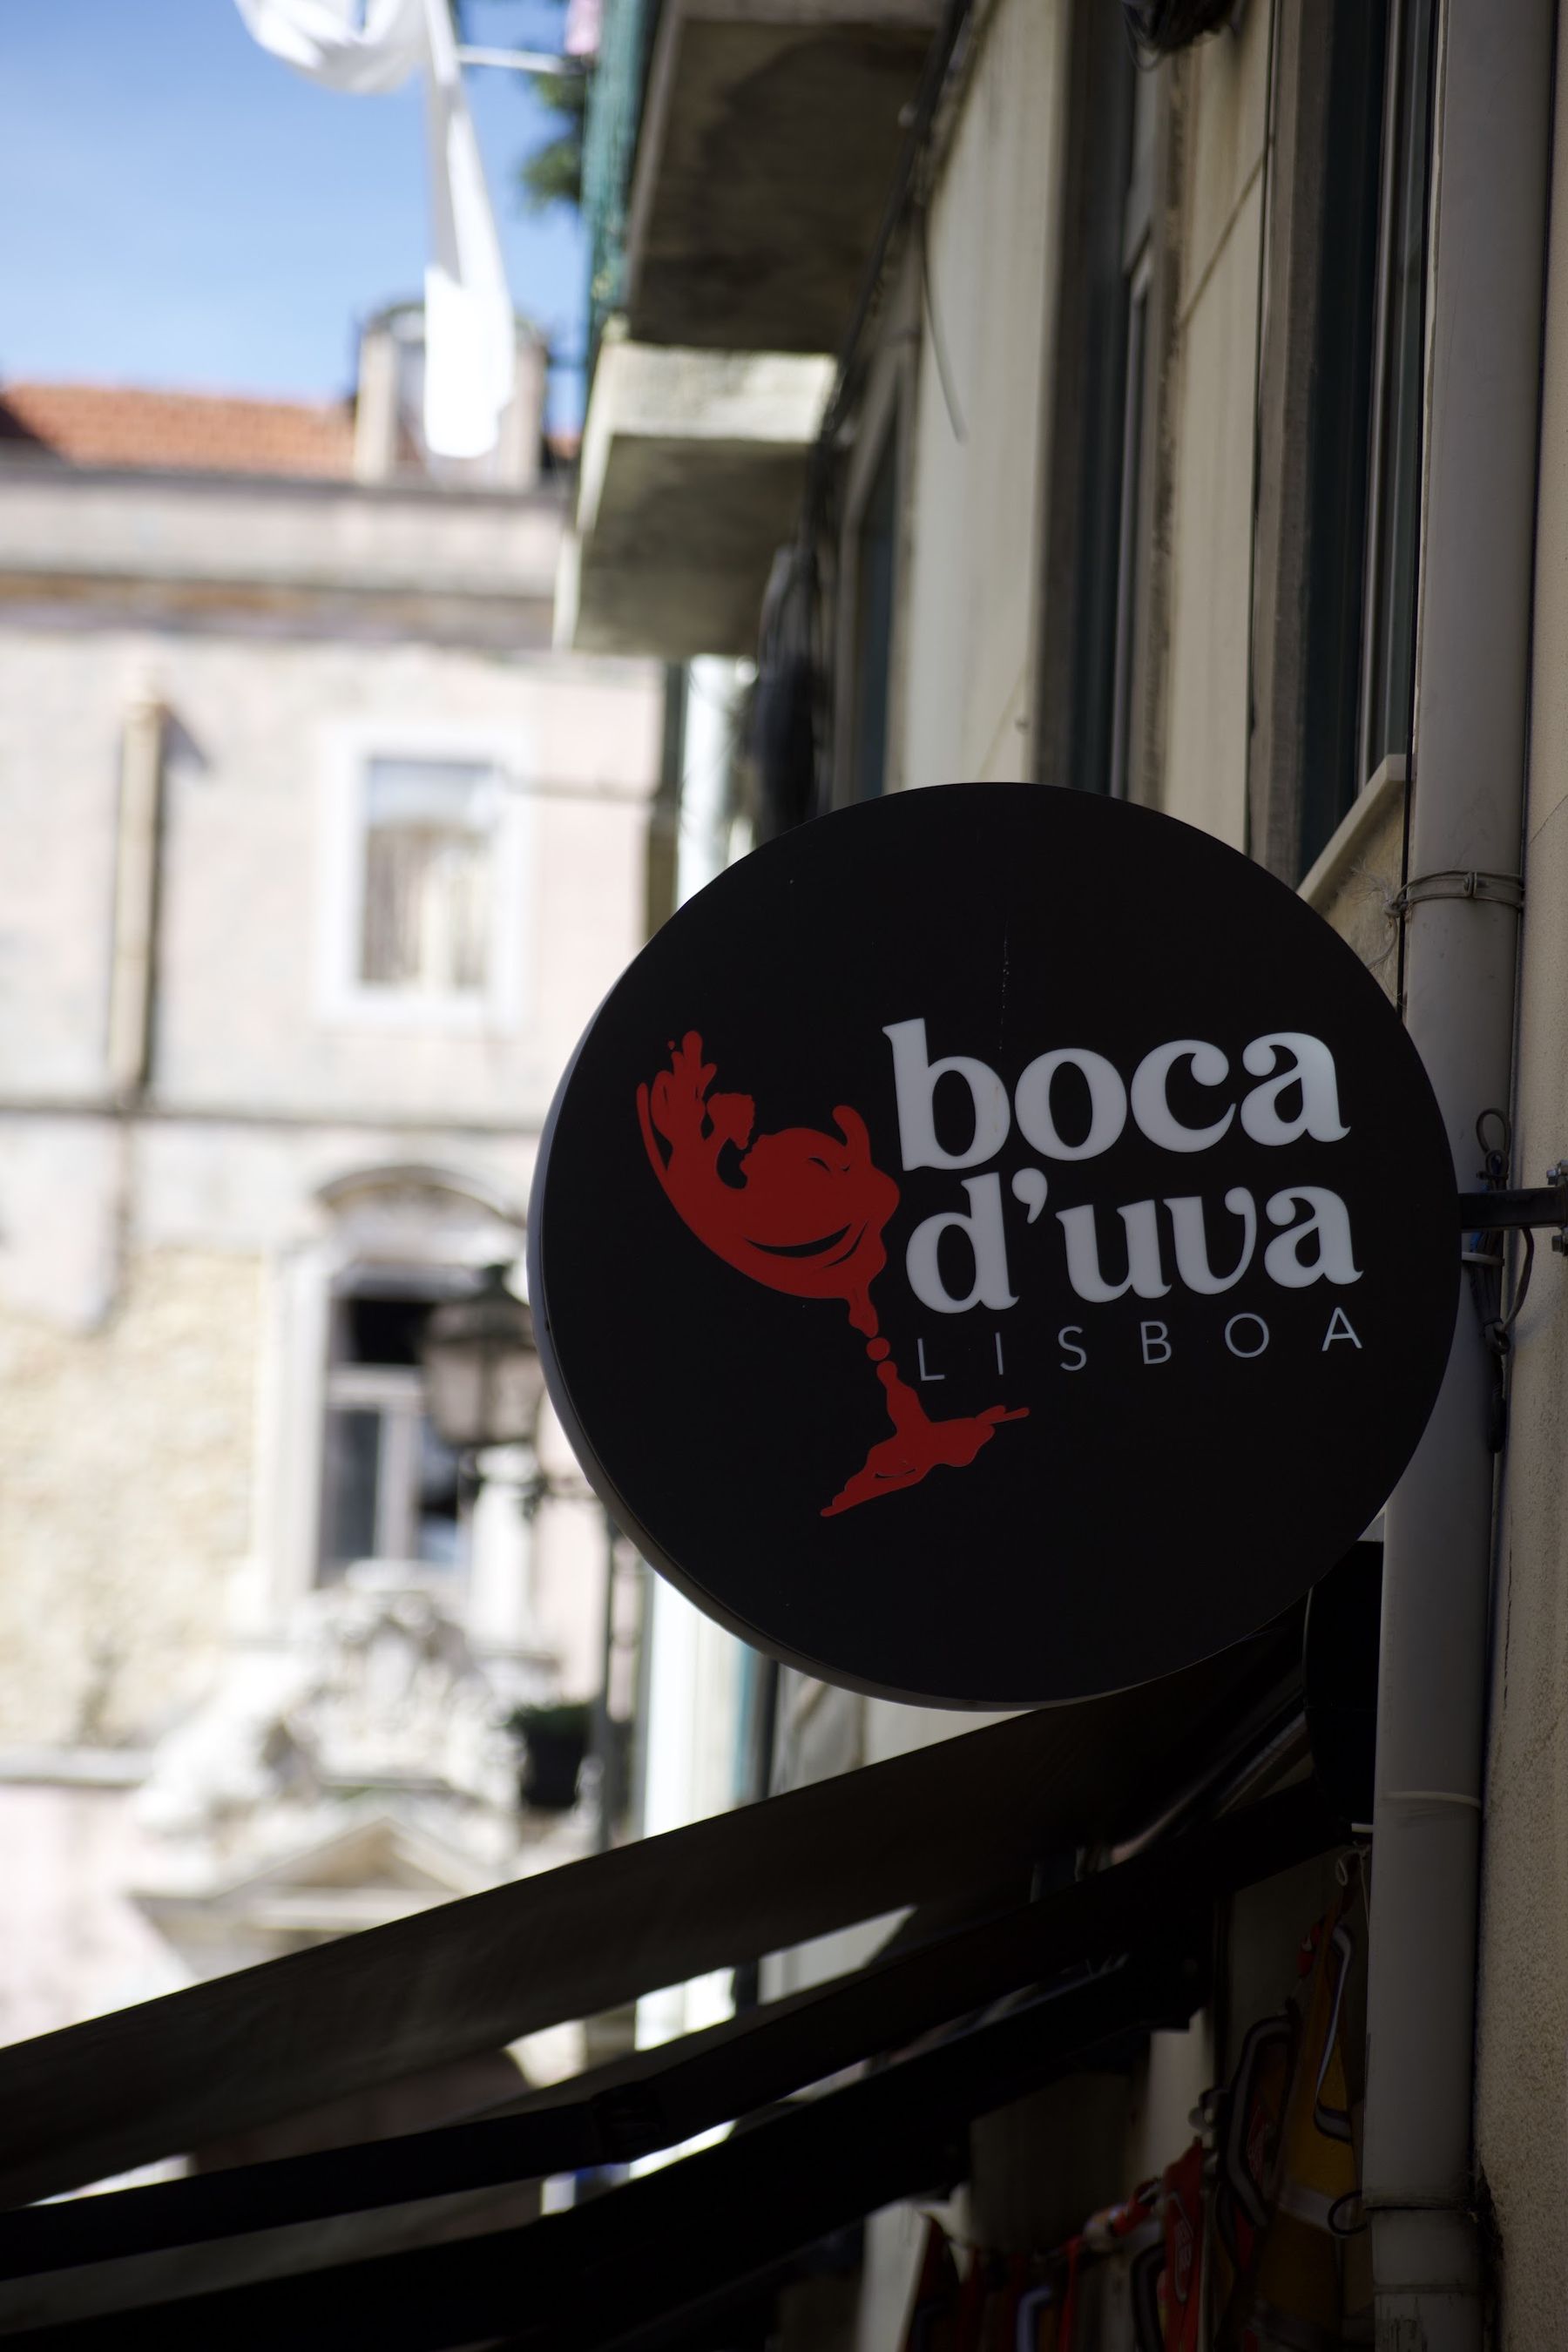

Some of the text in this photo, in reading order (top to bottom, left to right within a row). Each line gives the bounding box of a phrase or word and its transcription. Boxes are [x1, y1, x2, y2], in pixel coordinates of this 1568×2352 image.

[882, 1017, 1351, 1172] boca
[905, 1167, 1364, 1314] d'uva
[916, 1307, 1363, 1382] LISBOA
